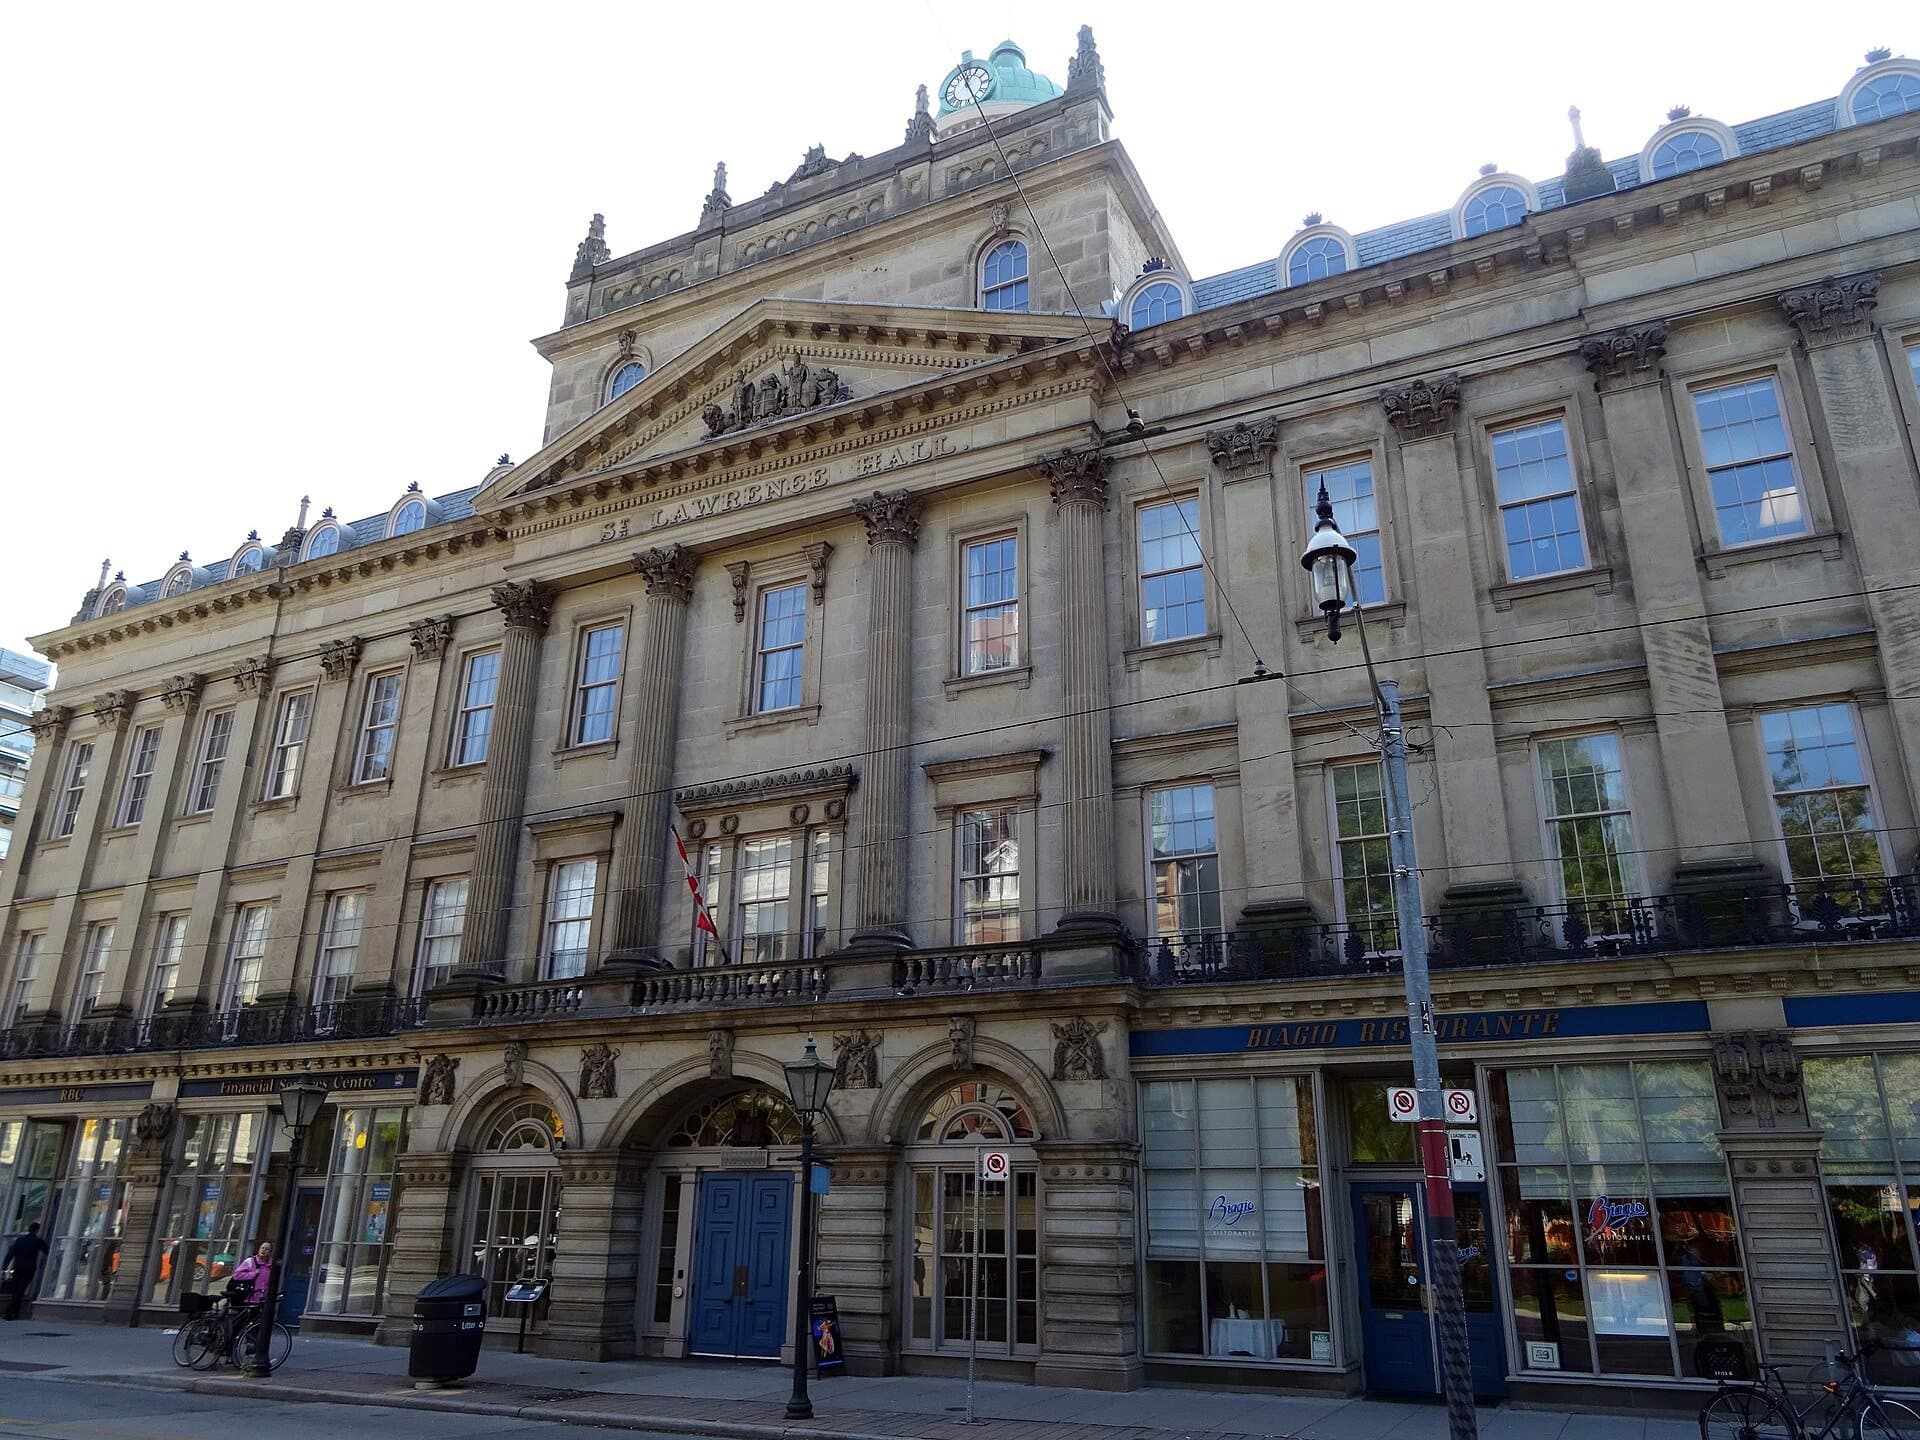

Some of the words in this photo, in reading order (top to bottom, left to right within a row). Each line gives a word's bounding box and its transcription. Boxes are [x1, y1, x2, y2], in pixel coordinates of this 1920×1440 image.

[651, 467, 830, 530] LAWRENCE
[856, 434, 970, 477] HALL.
[1247, 1024, 1337, 1048] BIAGIO
[1360, 1013, 1560, 1042] RISORANTE
[1421, 1001, 1431, 1034] T43
[60, 1087, 85, 1102] RBC
[220, 1078, 274, 1094] Financial
[333, 1075, 376, 1089] Centre
[1208, 1195, 1257, 1228] Biagio
[1597, 1234, 1652, 1242] RISTORANTE
